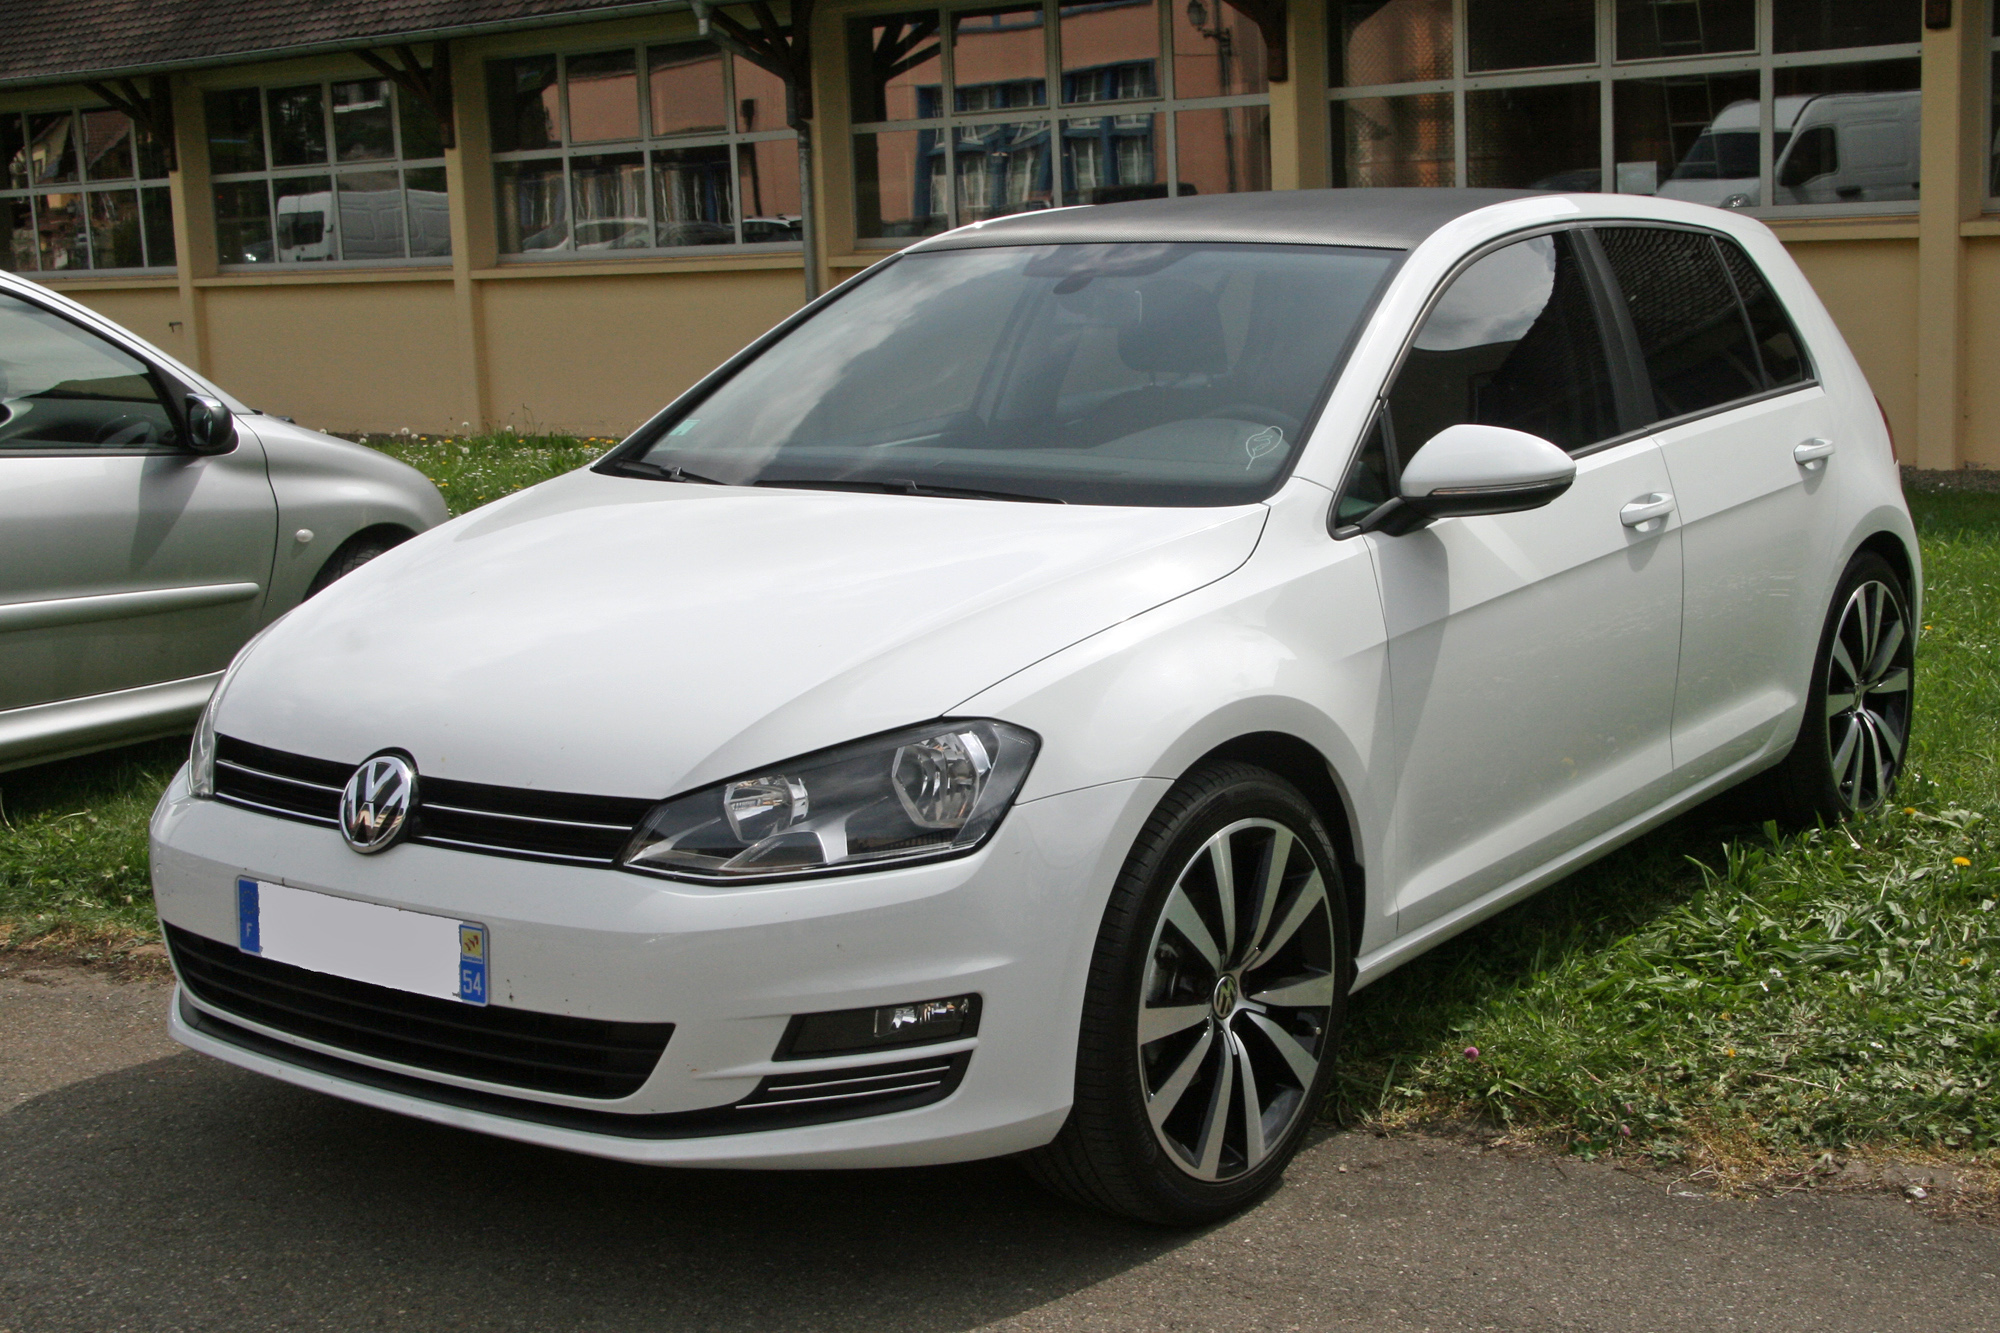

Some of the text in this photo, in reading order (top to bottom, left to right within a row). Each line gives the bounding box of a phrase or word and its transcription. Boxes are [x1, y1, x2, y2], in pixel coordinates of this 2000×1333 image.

[342, 757, 409, 850] VW
[246, 922, 253, 938] F
[462, 969, 482, 996] 54
